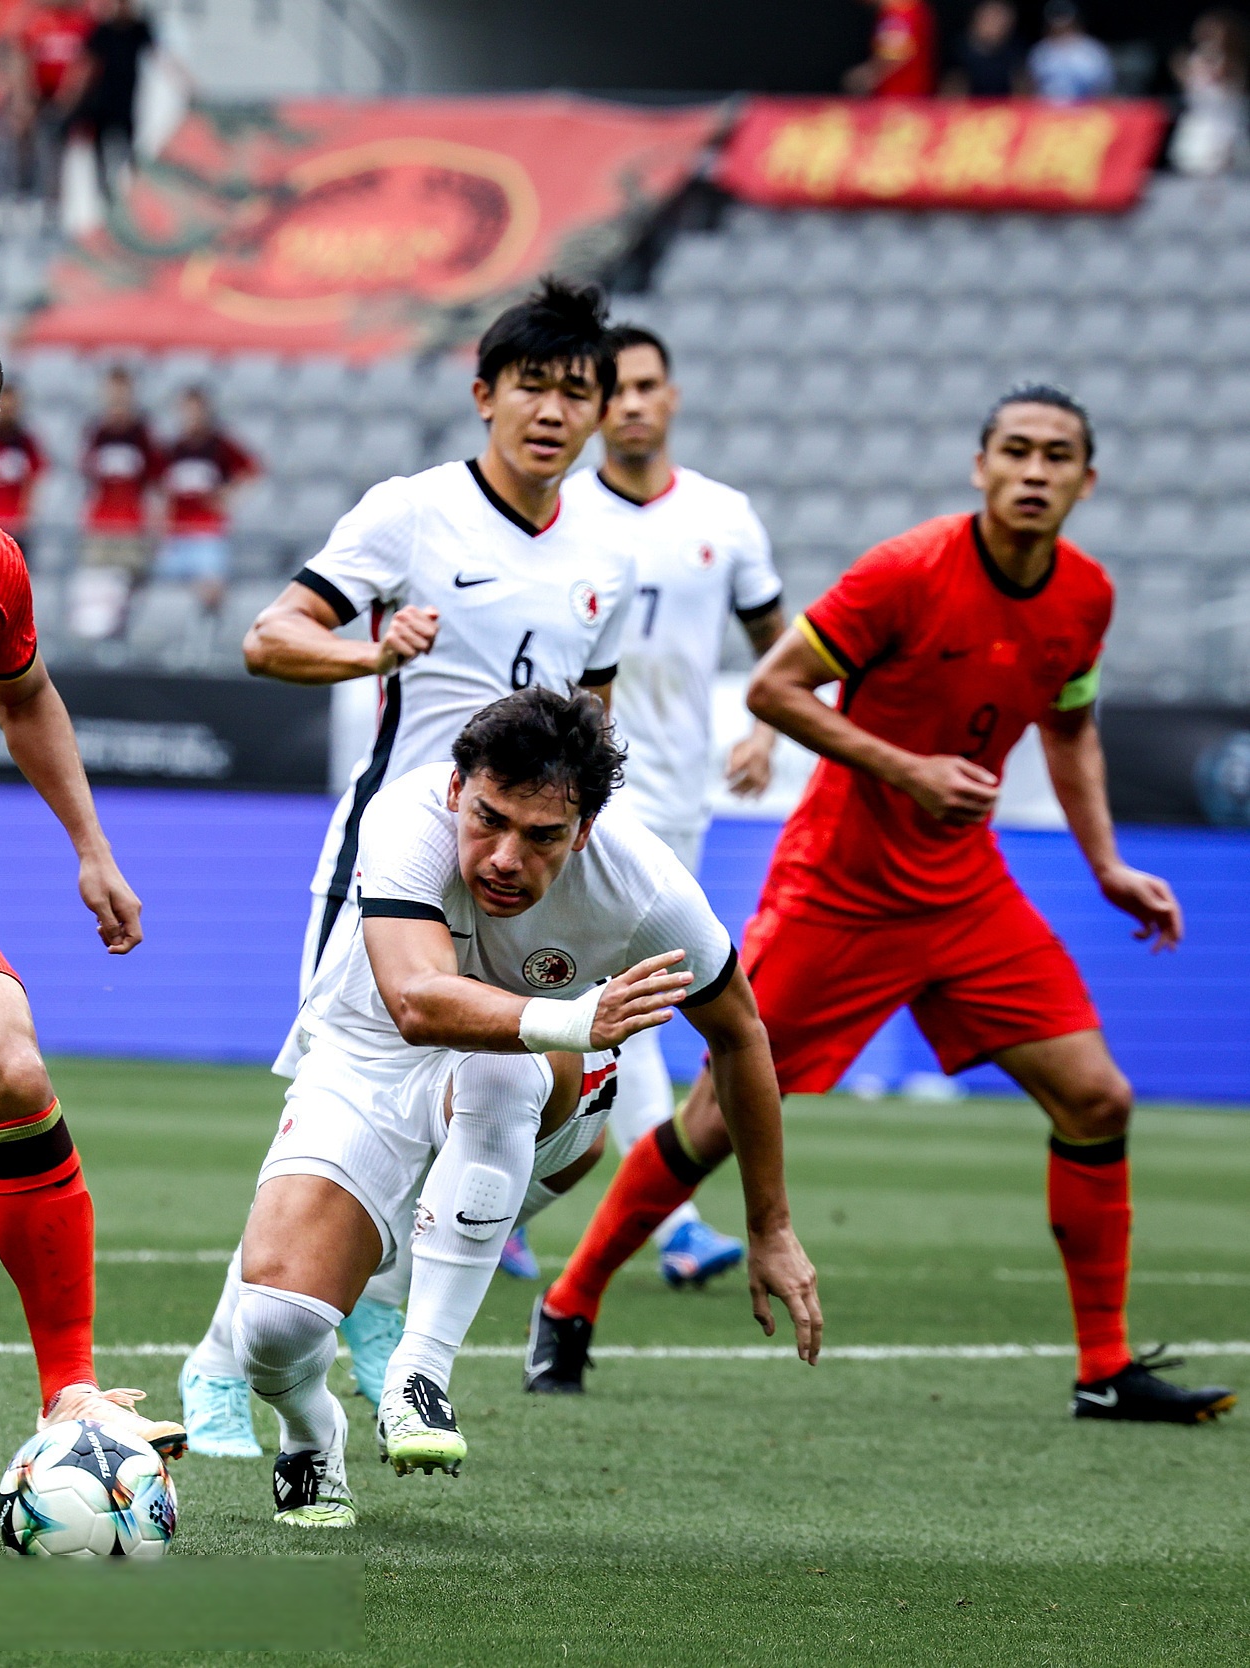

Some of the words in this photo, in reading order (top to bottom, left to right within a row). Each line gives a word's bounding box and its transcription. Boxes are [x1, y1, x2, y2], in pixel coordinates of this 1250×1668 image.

[639, 585, 660, 638] 7
[511, 630, 535, 691] 6
[959, 703, 999, 759] 9
